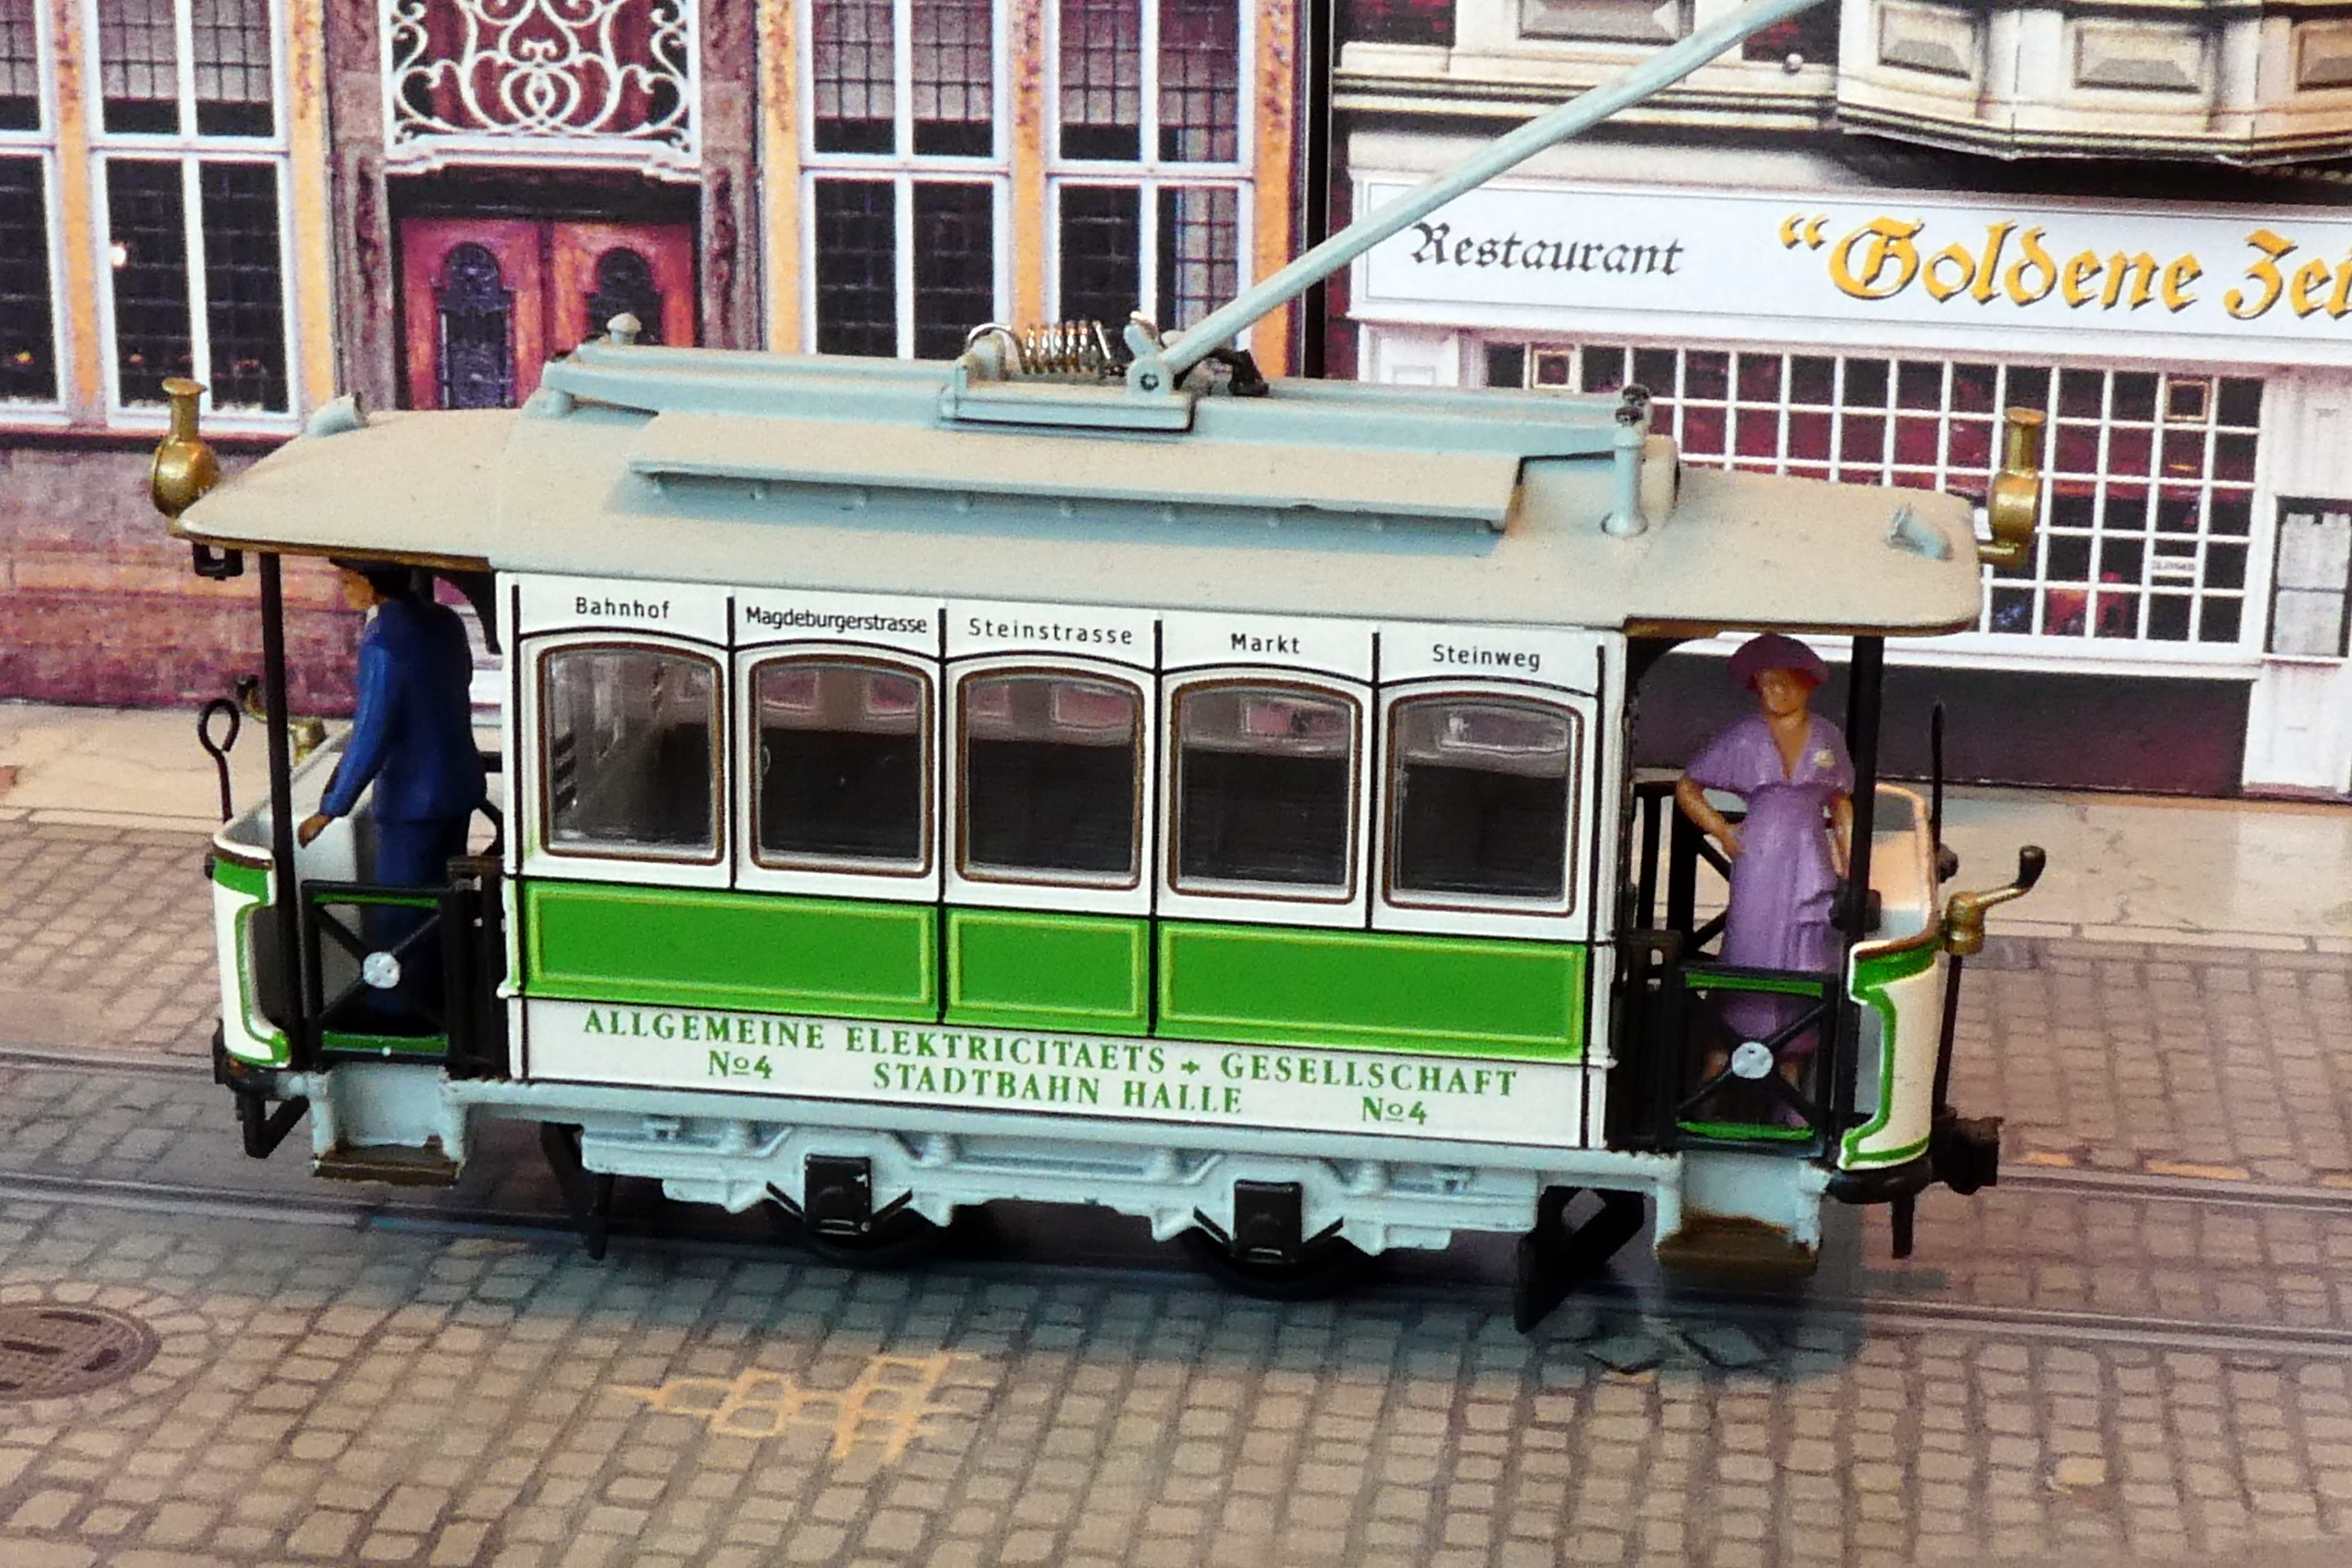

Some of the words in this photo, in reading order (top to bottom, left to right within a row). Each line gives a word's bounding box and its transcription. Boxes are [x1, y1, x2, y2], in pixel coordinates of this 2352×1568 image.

[1411, 221, 1684, 276] Restaurant
[576, 596, 670, 619] Bahnhof
[746, 606, 927, 634] Magdeburgerstrasse
[968, 617, 1132, 645] Steinstrasse
[1231, 633, 1300, 655] Markt
[1433, 644, 1540, 673] Steinweg
[583, 1009, 825, 1049] ALLGEMEINE
[845, 1026, 1165, 1074] ELEKTRICITAETS
[1220, 1052, 1518, 1097] GESELLSCHAFT
[873, 1061, 1100, 1105] STADTBAHN
[1123, 1079, 1242, 1114] HALLE
